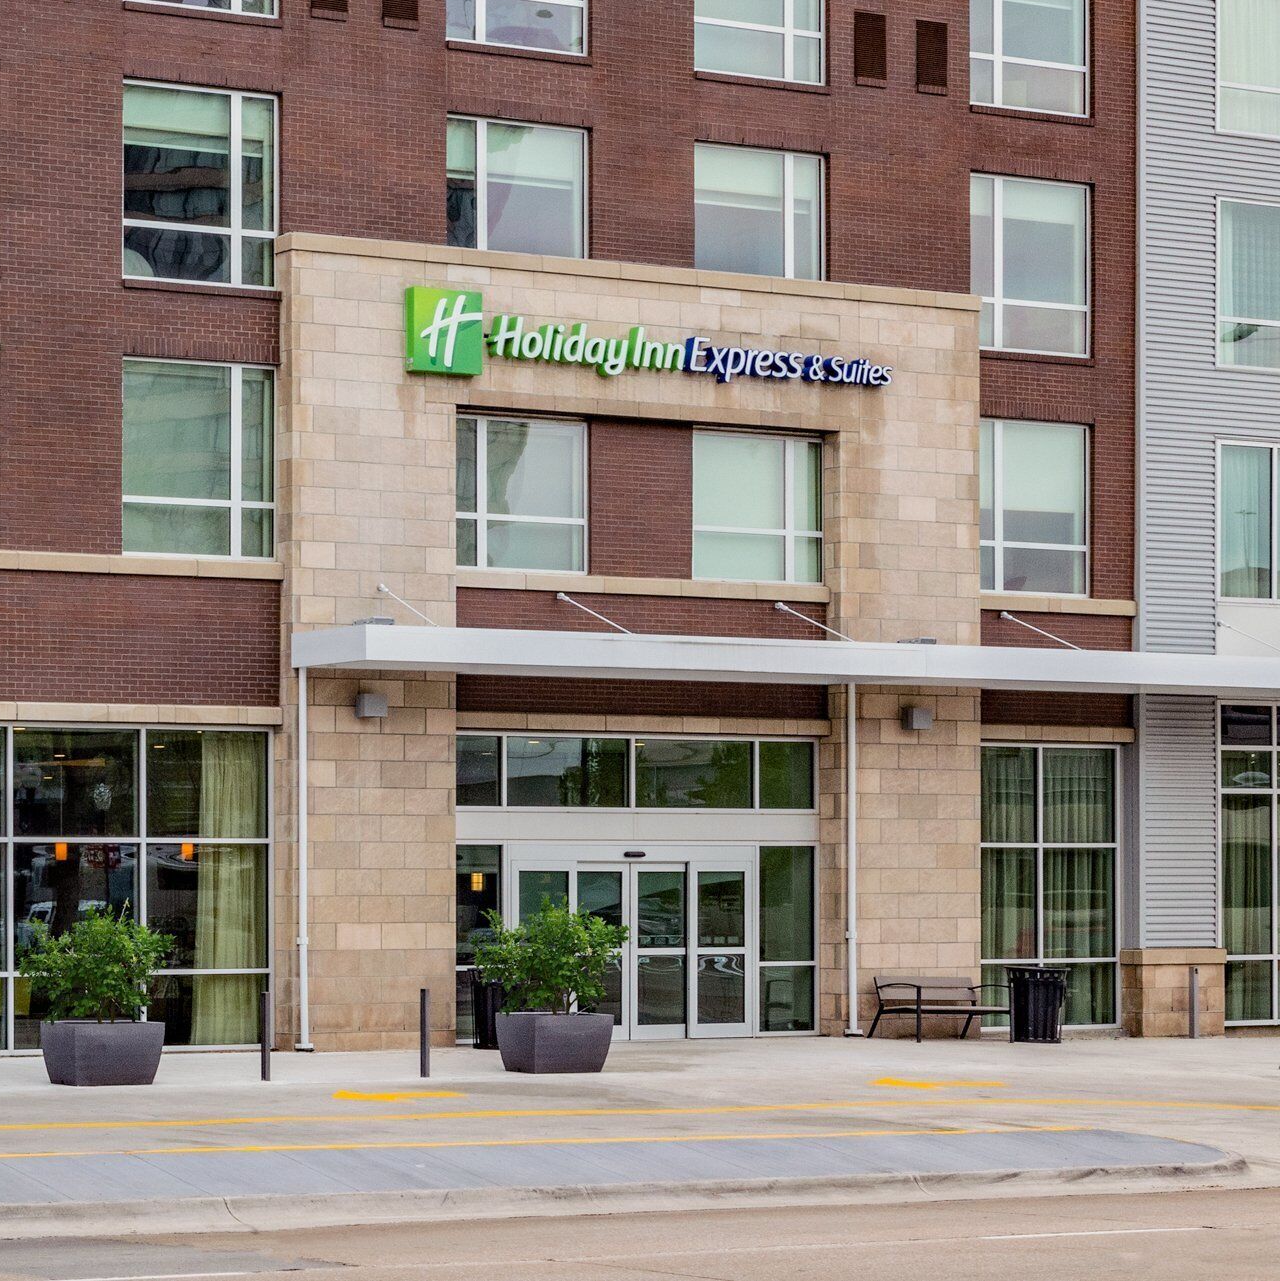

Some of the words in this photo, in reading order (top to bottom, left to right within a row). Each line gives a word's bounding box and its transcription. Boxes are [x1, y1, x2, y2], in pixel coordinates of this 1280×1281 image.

[420, 294, 482, 367] H
[488, 314, 628, 376] Holiday
[628, 326, 686, 371] Inn
[687, 336, 803, 383] Express
[804, 355, 827, 381] &
[827, 357, 893, 386] Suites
